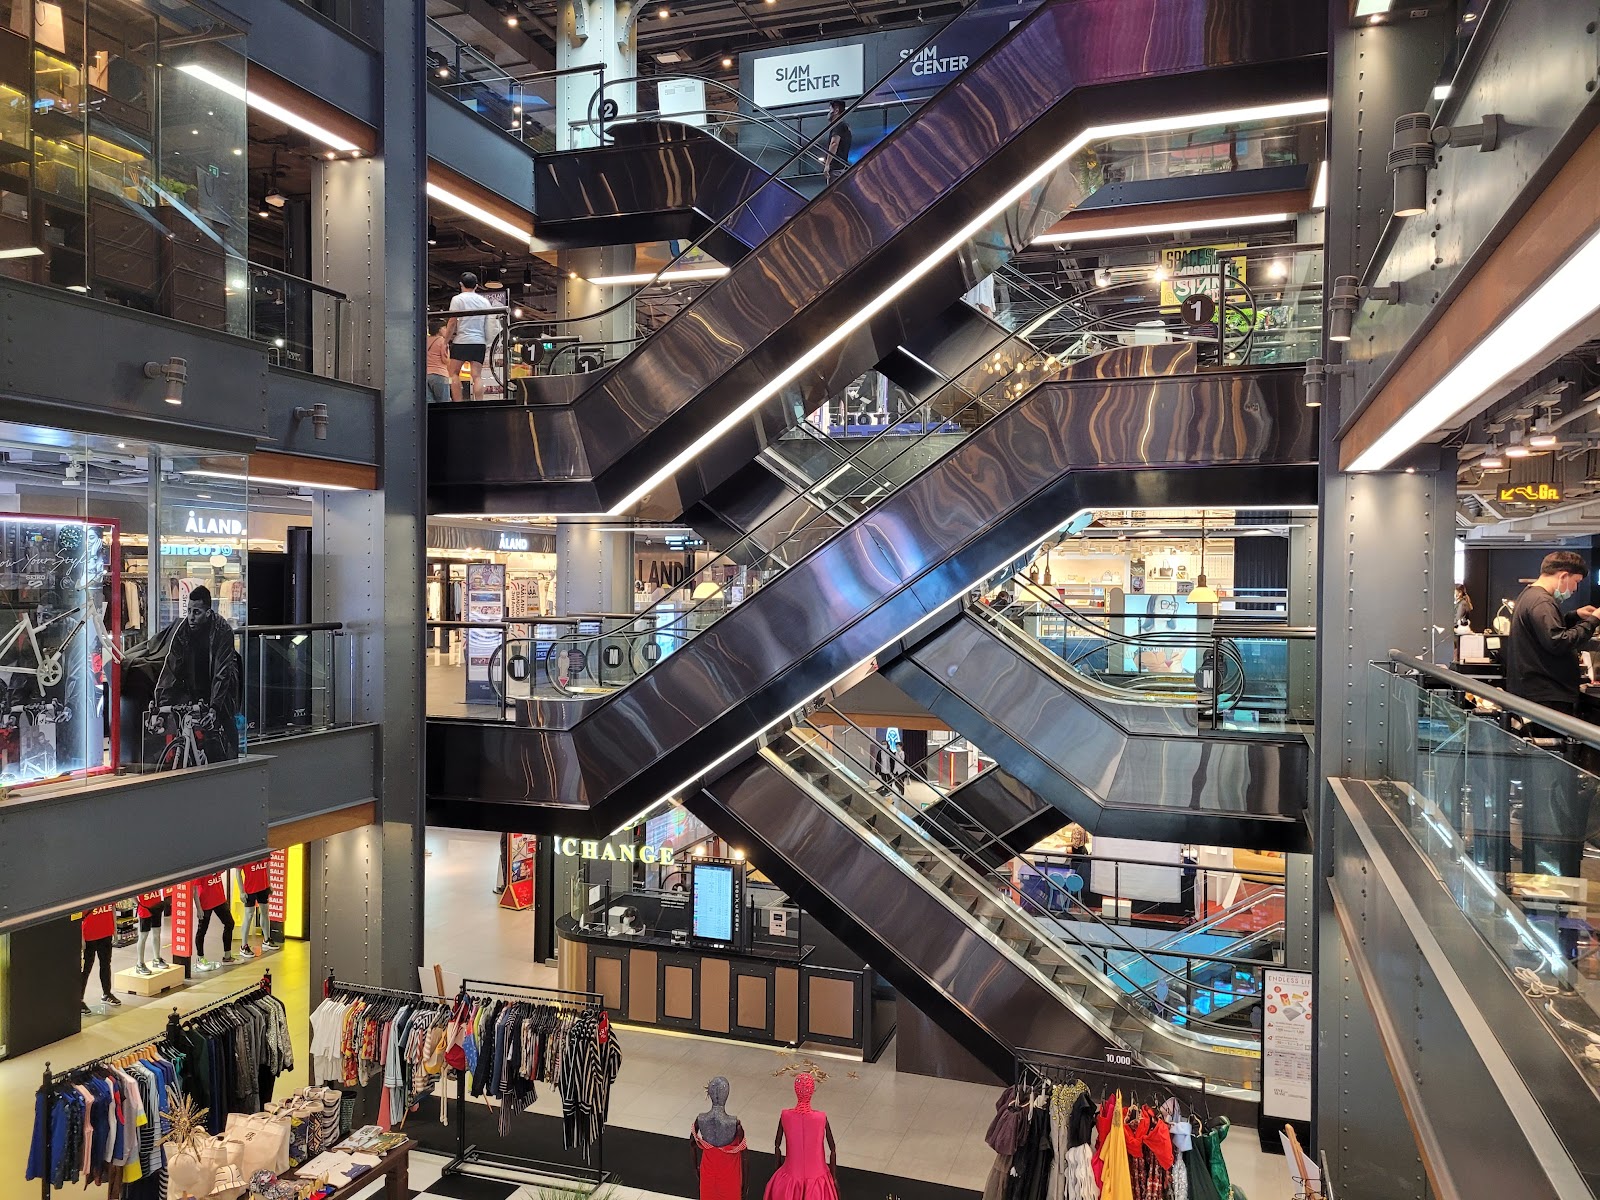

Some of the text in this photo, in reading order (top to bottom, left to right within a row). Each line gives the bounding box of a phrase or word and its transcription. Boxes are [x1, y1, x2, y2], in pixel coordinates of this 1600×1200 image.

[775, 64, 810, 82] SIAM
[911, 55, 969, 76] CENTER
[787, 74, 840, 93] CENTER
[603, 103, 614, 118] 2
[1190, 300, 1202, 321] 1
[527, 344, 536, 361] 1
[581, 360, 589, 374] 1
[635, 559, 684, 589] LAND
[609, 648, 619, 665] M
[513, 659, 525, 678] M
[251, 861, 267, 872] SALE
[143, 890, 162, 901] SAL
[268, 896, 283, 904] SALE
[92, 904, 113, 915] SALE
[1268, 975, 1299, 984] ENDLESS
[1105, 1053, 1131, 1066] 10,000
